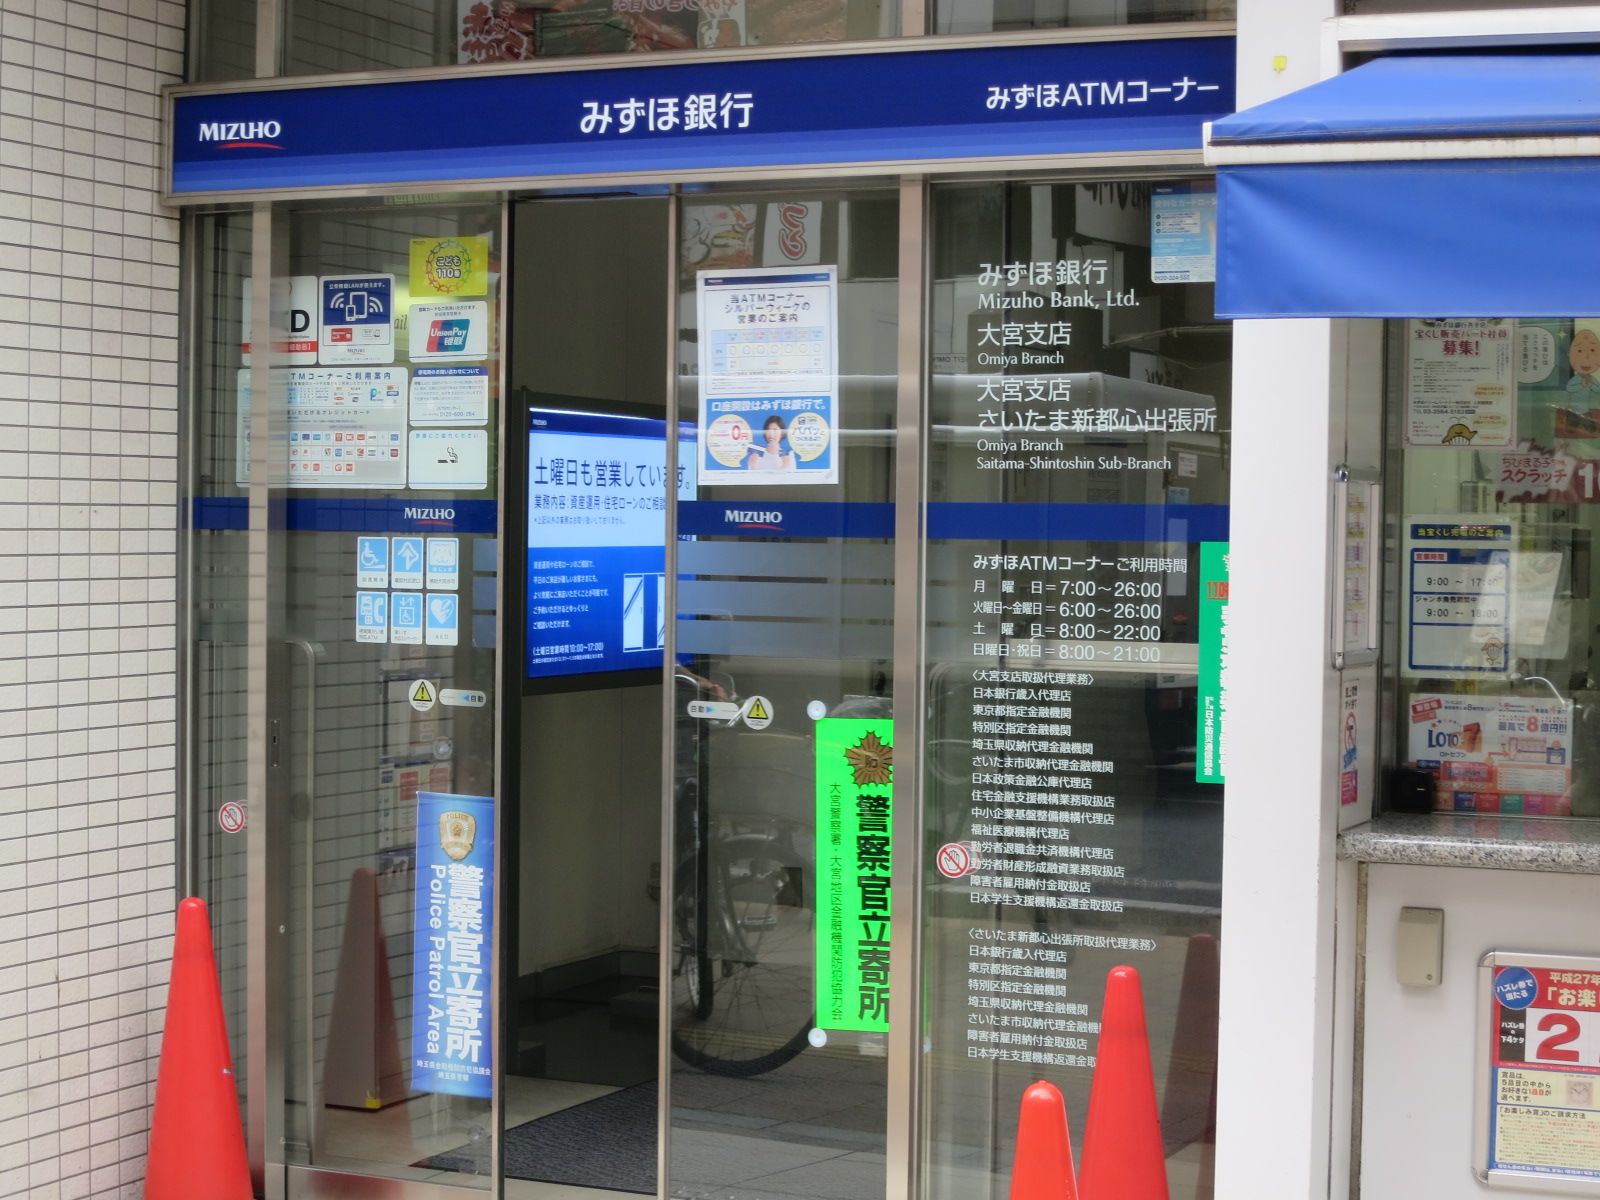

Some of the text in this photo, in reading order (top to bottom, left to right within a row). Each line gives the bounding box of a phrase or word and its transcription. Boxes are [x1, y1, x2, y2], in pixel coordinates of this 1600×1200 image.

[985, 79, 1221, 112] みずほATMコーナー
[579, 91, 755, 136] みずほ銀行
[197, 119, 282, 143] MIZUHO
[977, 259, 1108, 287] みずほ銀行
[977, 289, 1141, 311] Mizuho Bank, Ltd.
[430, 326, 467, 338] UnionPay
[977, 321, 1072, 347] 大宮支店
[977, 353, 1018, 368] Omiya
[1021, 352, 1065, 365] Branch
[976, 377, 1072, 402] 大宮支店
[976, 407, 1218, 433] さいたま新都心出張所
[976, 438, 1064, 454] Omiya Branch
[976, 455, 1172, 470] Saitama-Shintoshin Sub-Branch
[403, 507, 456, 520] MIZUHO
[724, 509, 783, 523] MIZUHO
[972, 553, 1188, 574] みずほATMコーナーご利用時間
[1426, 577, 1449, 586] 9:00
[1426, 608, 1449, 617] 9:00
[972, 687, 1072, 702] 日本銀行歳入代理店
[972, 703, 1072, 720] 東京都指定金融機関
[972, 720, 1072, 737] 特別区指定金融機関
[971, 737, 1094, 755] 埼玉県収納代理金融機関
[971, 755, 1114, 774] さいたま市収納代理金融機関
[971, 773, 1093, 790] 日本政策金融公庫代理店
[971, 789, 1116, 809] 住宅金融支援機構業務取扱店
[971, 806, 1115, 825] 中小企業基盤整備機構代理店
[970, 823, 1070, 841] 福祉医療機構代理店
[970, 875, 1092, 894] 障害者雇用納付金取扱店
[855, 794, 891, 1023] 警察官立寄所
[970, 892, 1124, 914] 日本学生支援機構返還金取扱店
[426, 863, 447, 1054] Police Patrol Area
[445, 863, 485, 1063] 警察官立寄所
[968, 944, 1067, 963] 日本銀行歳入代理店
[968, 962, 1067, 981] 東京都指定金融機関
[967, 979, 1067, 998] 特別区指定金融機関
[967, 995, 1089, 1016] 埼玉県収納代理金融機関
[967, 1012, 1102, 1035] さいたま市収納代理金融機
[967, 1028, 1088, 1051] 障害者雇用納付金取扱店
[1535, 1012, 1581, 1063] 2
